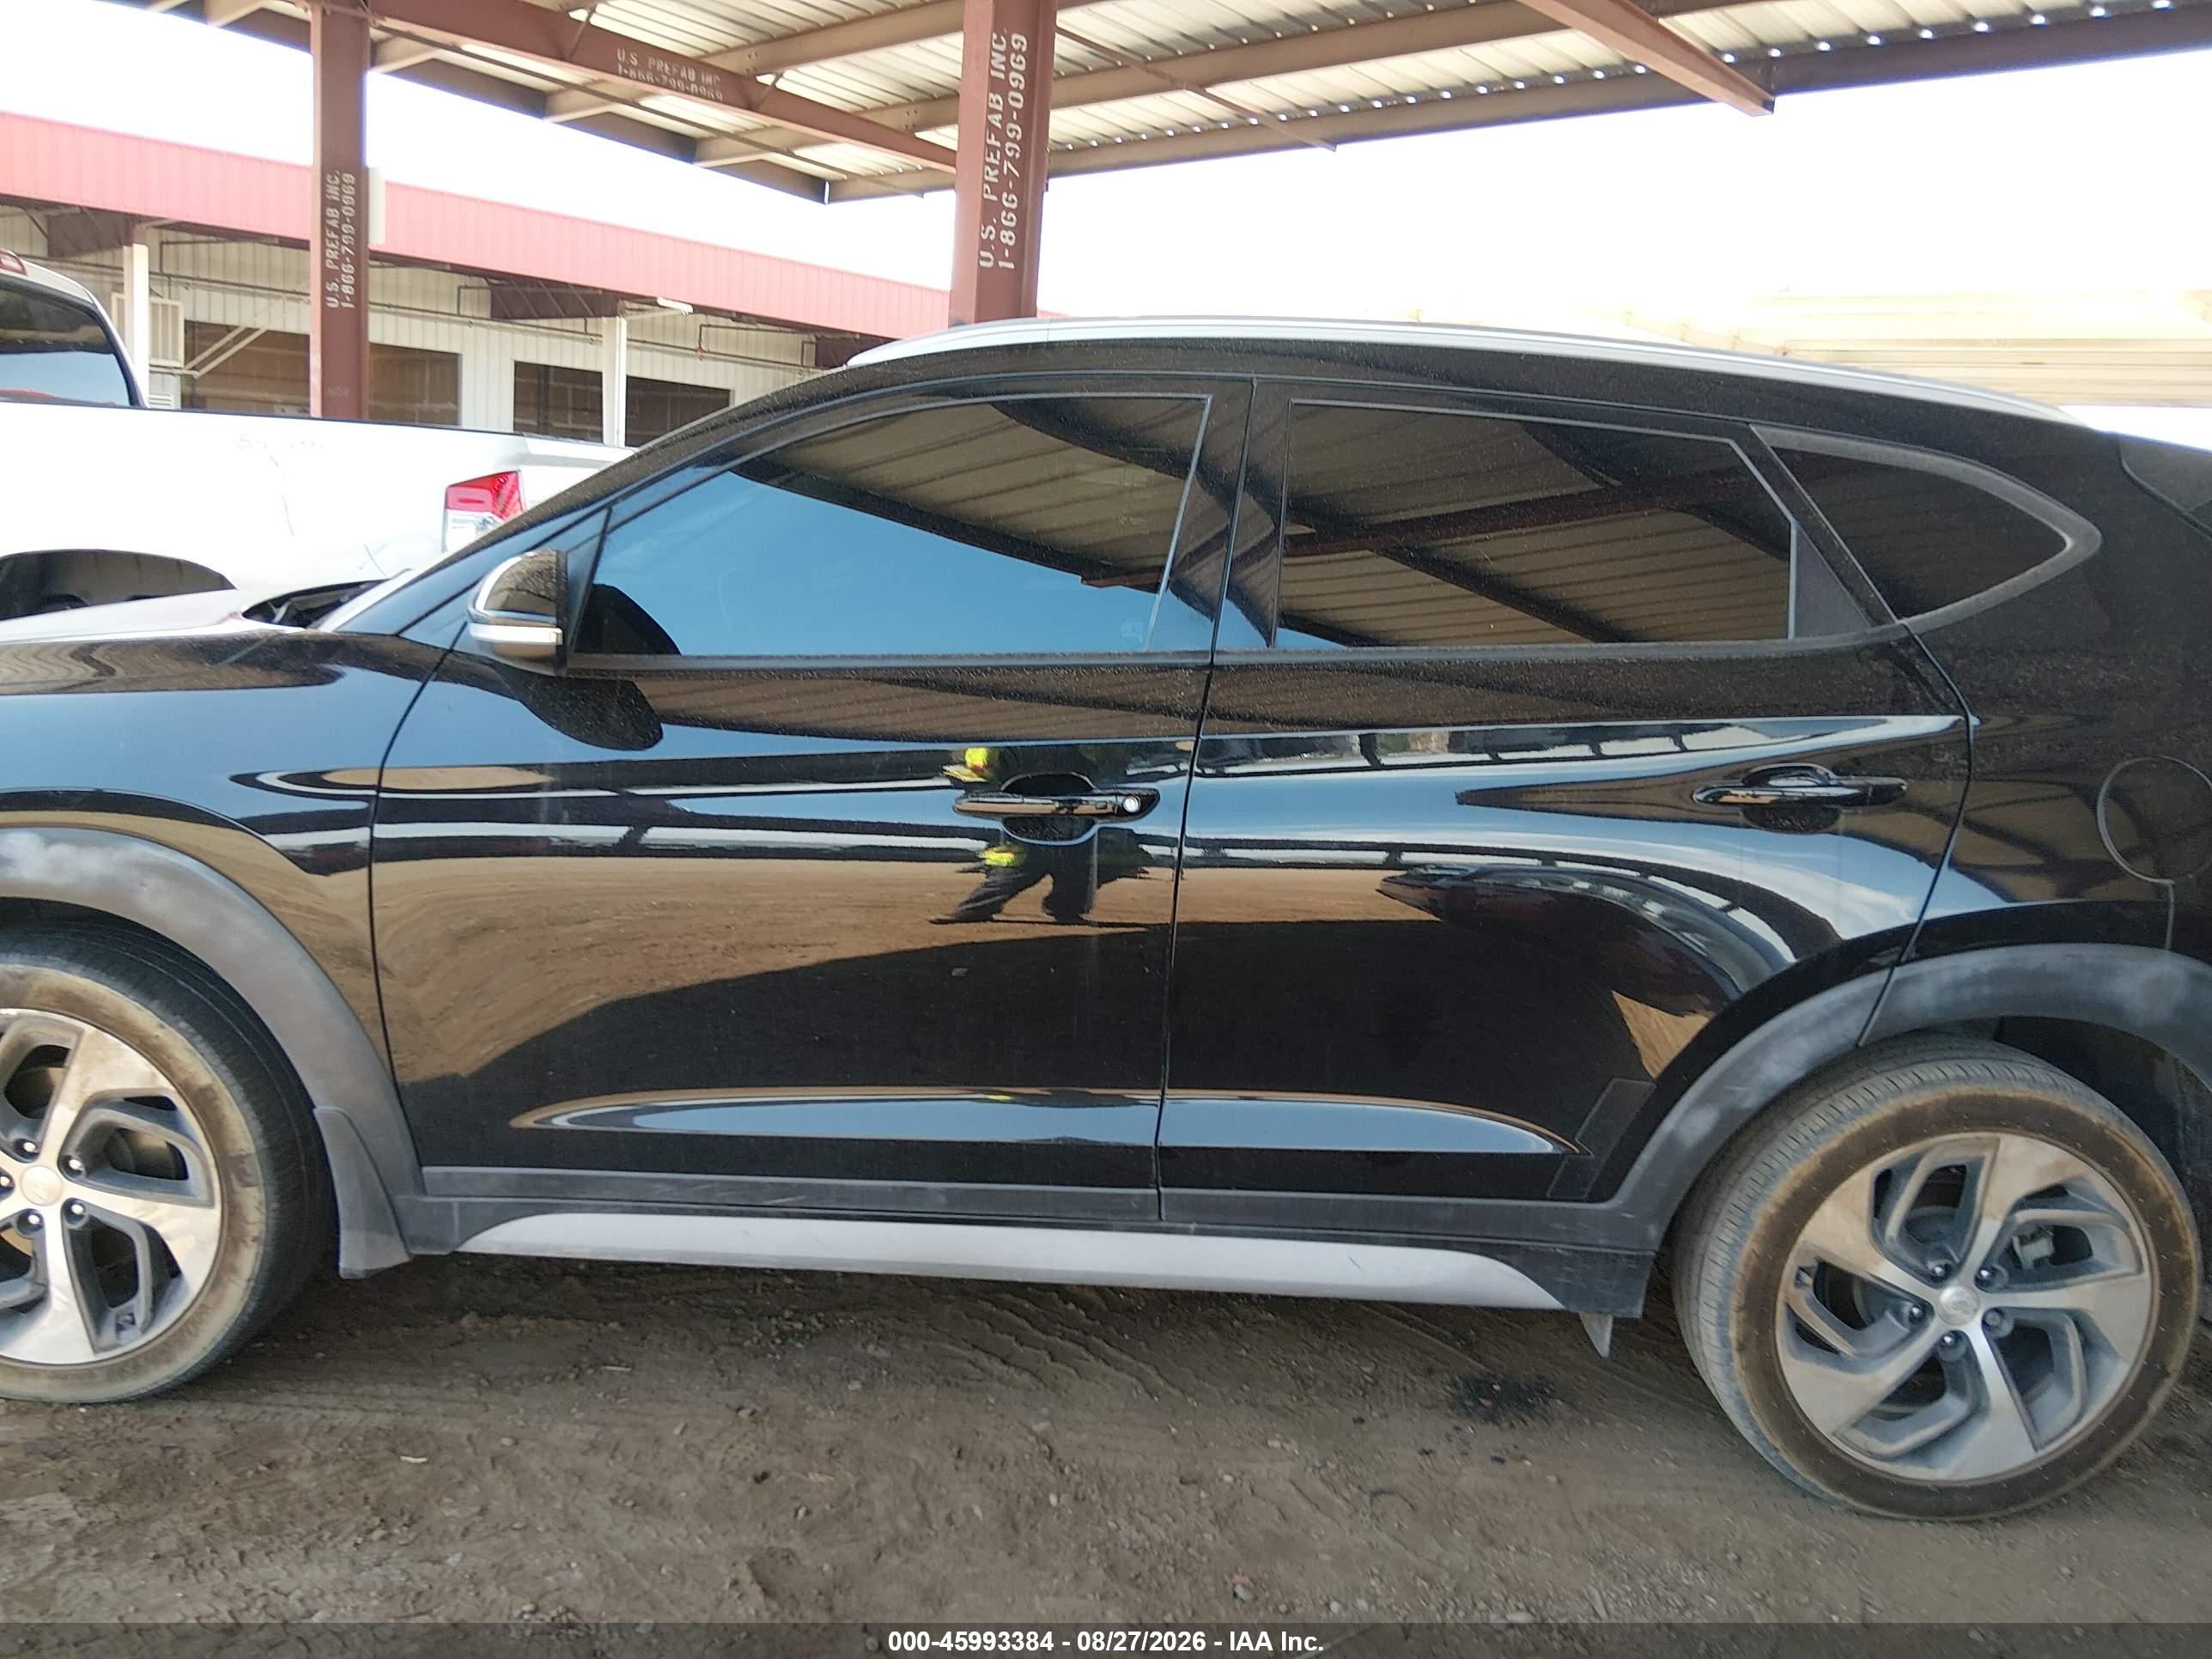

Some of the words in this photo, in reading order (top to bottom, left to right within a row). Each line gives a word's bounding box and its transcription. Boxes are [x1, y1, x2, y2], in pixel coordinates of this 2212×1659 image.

[647, 56, 696, 82] PREFAB
[990, 27, 1007, 80] INC.
[982, 92, 1004, 202] PREFAB
[998, 33, 1028, 270] 1-866-799-0969
[325, 207, 340, 271] PREFAB
[341, 173, 356, 309] 1-866-799-0969
[979, 217, 997, 269] U.S.
[325, 278, 340, 309] U.S.
